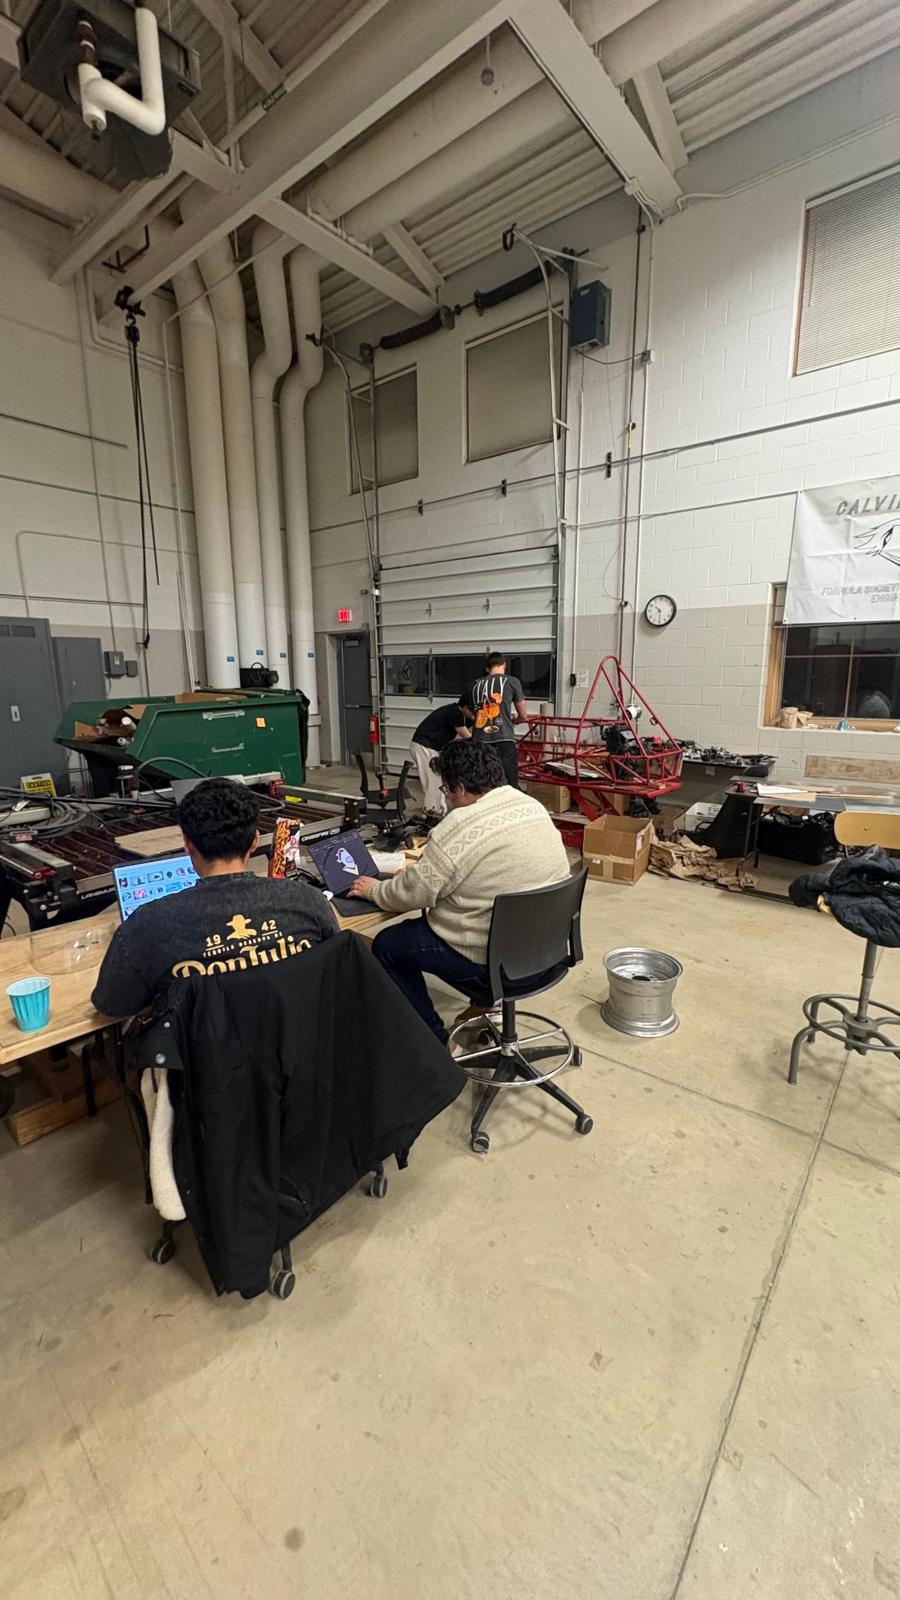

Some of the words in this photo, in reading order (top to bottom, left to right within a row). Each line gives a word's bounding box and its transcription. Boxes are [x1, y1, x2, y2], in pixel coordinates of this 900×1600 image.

[836, 494, 900, 516] CALVI
[206, 934, 222, 947] 19
[261, 919, 277, 931] 42
